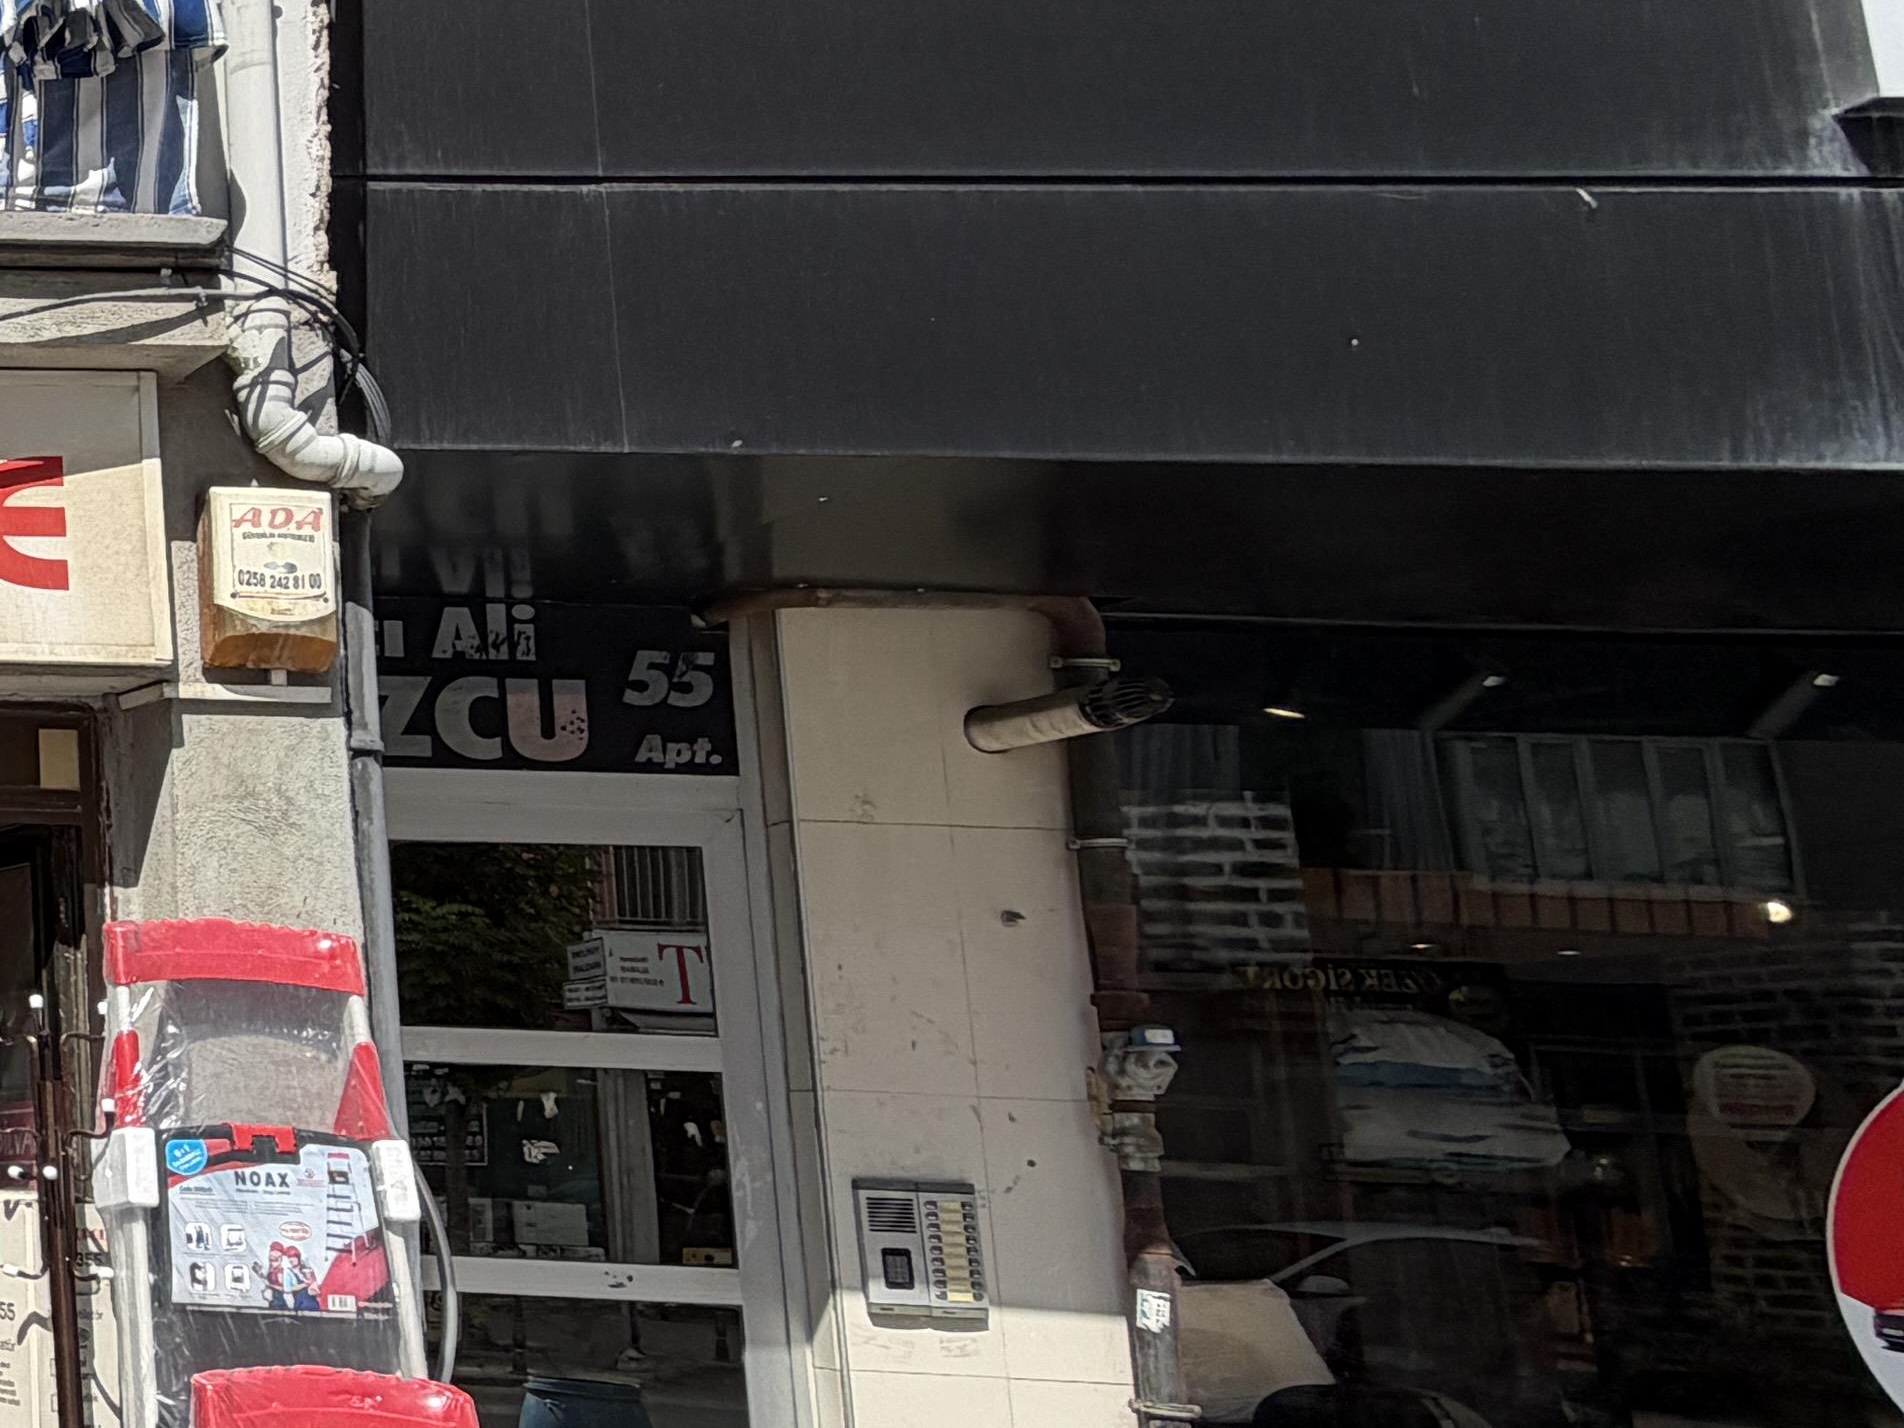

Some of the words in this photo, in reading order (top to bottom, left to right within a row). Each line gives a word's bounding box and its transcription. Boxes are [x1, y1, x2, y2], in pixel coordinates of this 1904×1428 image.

[231, 506, 324, 532] ADA
[237, 569, 266, 587] 0258
[269, 575, 290, 589] 242
[292, 574, 305, 590] 81
[431, 604, 537, 662] Ali
[622, 650, 715, 708] 55
[383, 675, 590, 762] ZCU
[634, 734, 722, 769] Apt.
[234, 1169, 291, 1189] NOAX
